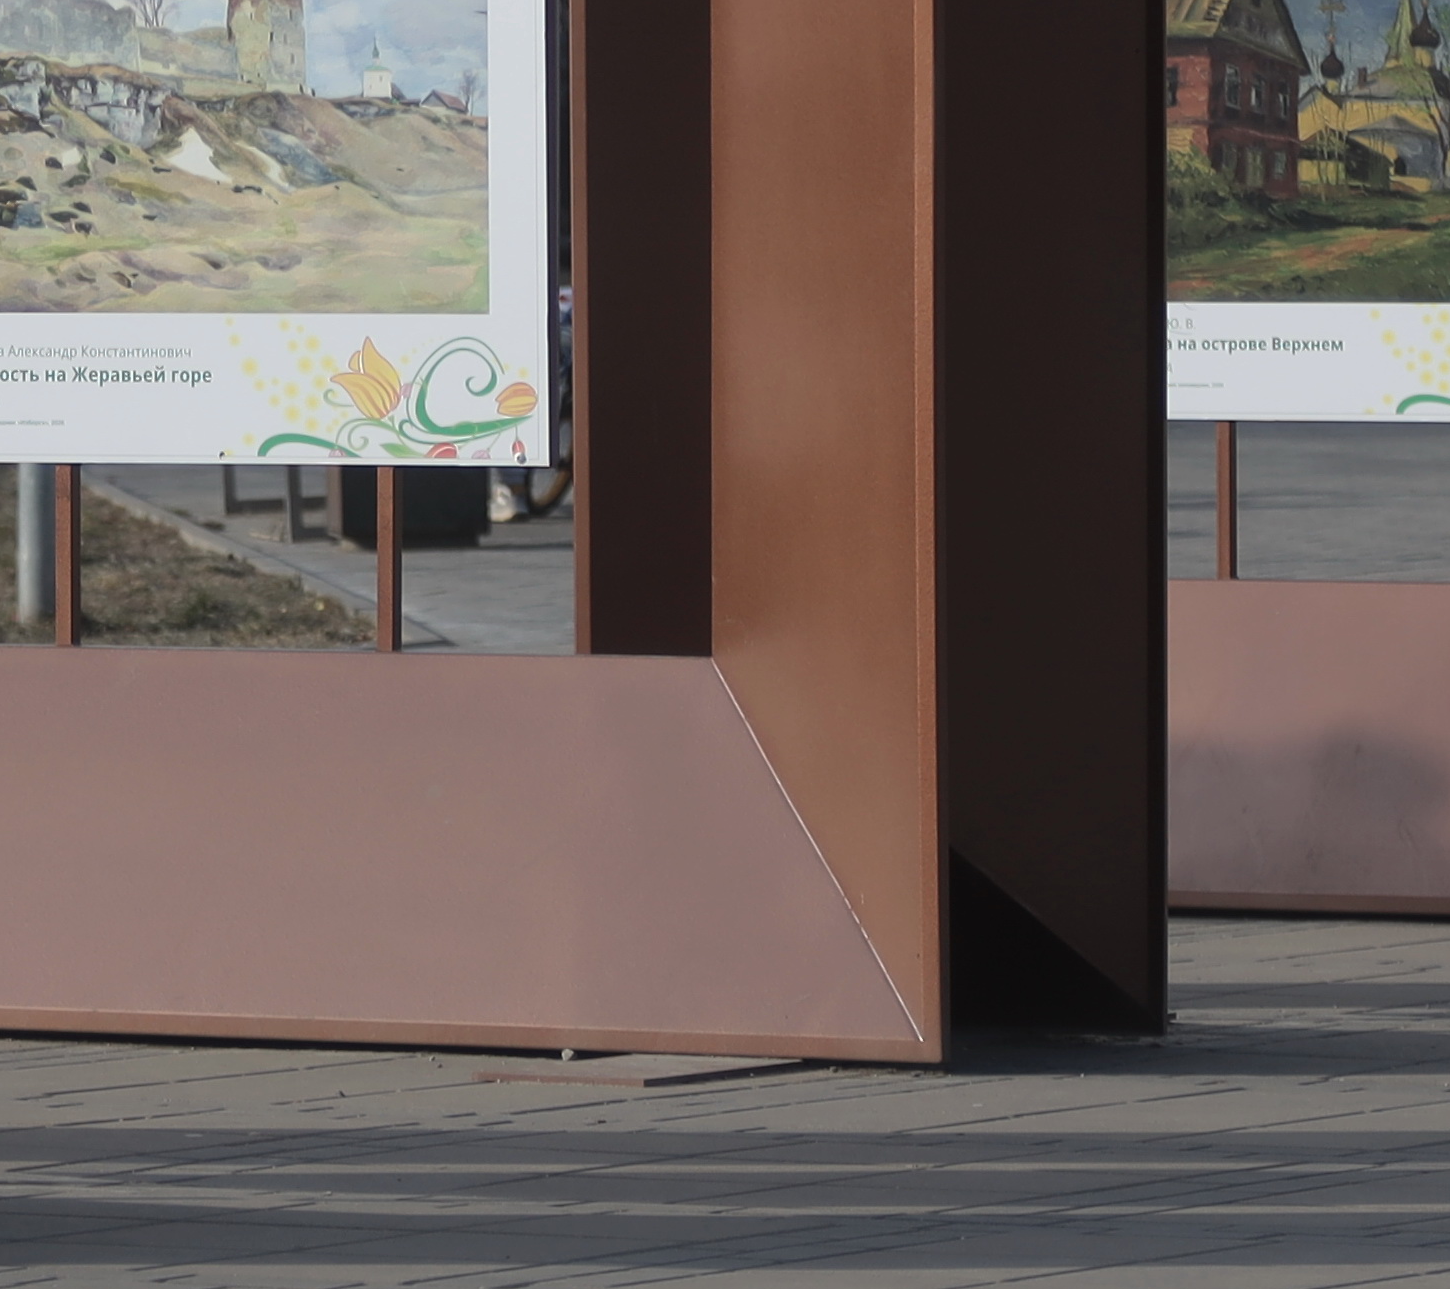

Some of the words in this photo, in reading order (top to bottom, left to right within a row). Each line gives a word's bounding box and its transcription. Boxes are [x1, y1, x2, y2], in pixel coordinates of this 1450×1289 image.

[1186, 318, 1196, 330] В.
[8, 345, 78, 361] Александр
[81, 345, 192, 359] Константинович
[1177, 339, 1196, 351] на
[1201, 339, 1268, 355] острове
[1272, 337, 1344, 355] Верхнем
[45, 370, 67, 383] на
[72, 366, 166, 386] Жеравьей
[171, 370, 213, 387] горе
